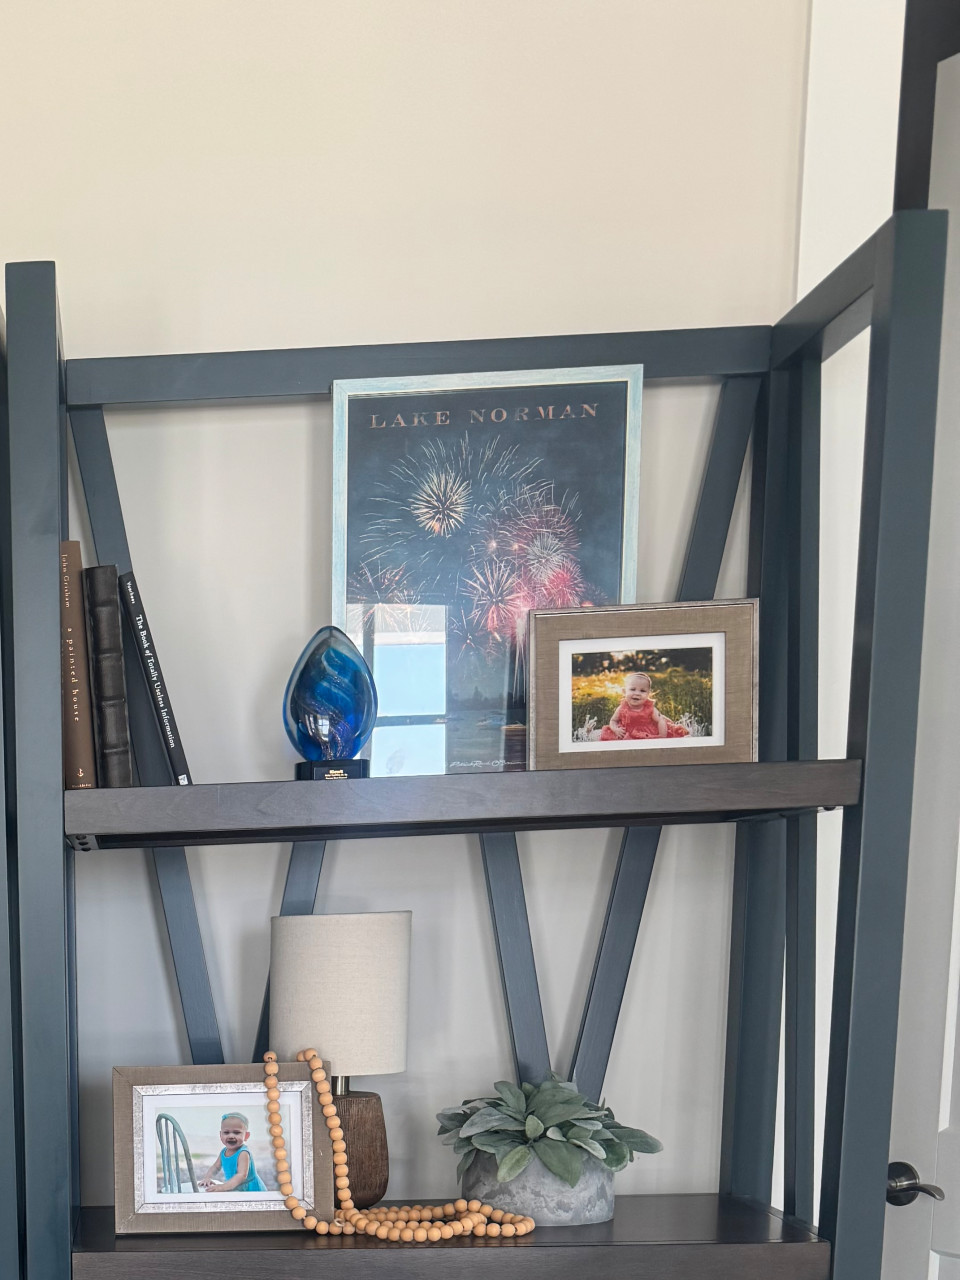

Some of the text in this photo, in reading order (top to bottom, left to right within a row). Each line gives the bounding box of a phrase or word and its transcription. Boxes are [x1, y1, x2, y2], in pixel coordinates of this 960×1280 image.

[369, 403, 598, 428] LAKE NORMAN
[66, 640, 78, 683] painted
[140, 630, 150, 648] Book
[148, 657, 158, 680] Totally
[154, 682, 164, 707] Useless
[161, 708, 174, 748] Information
